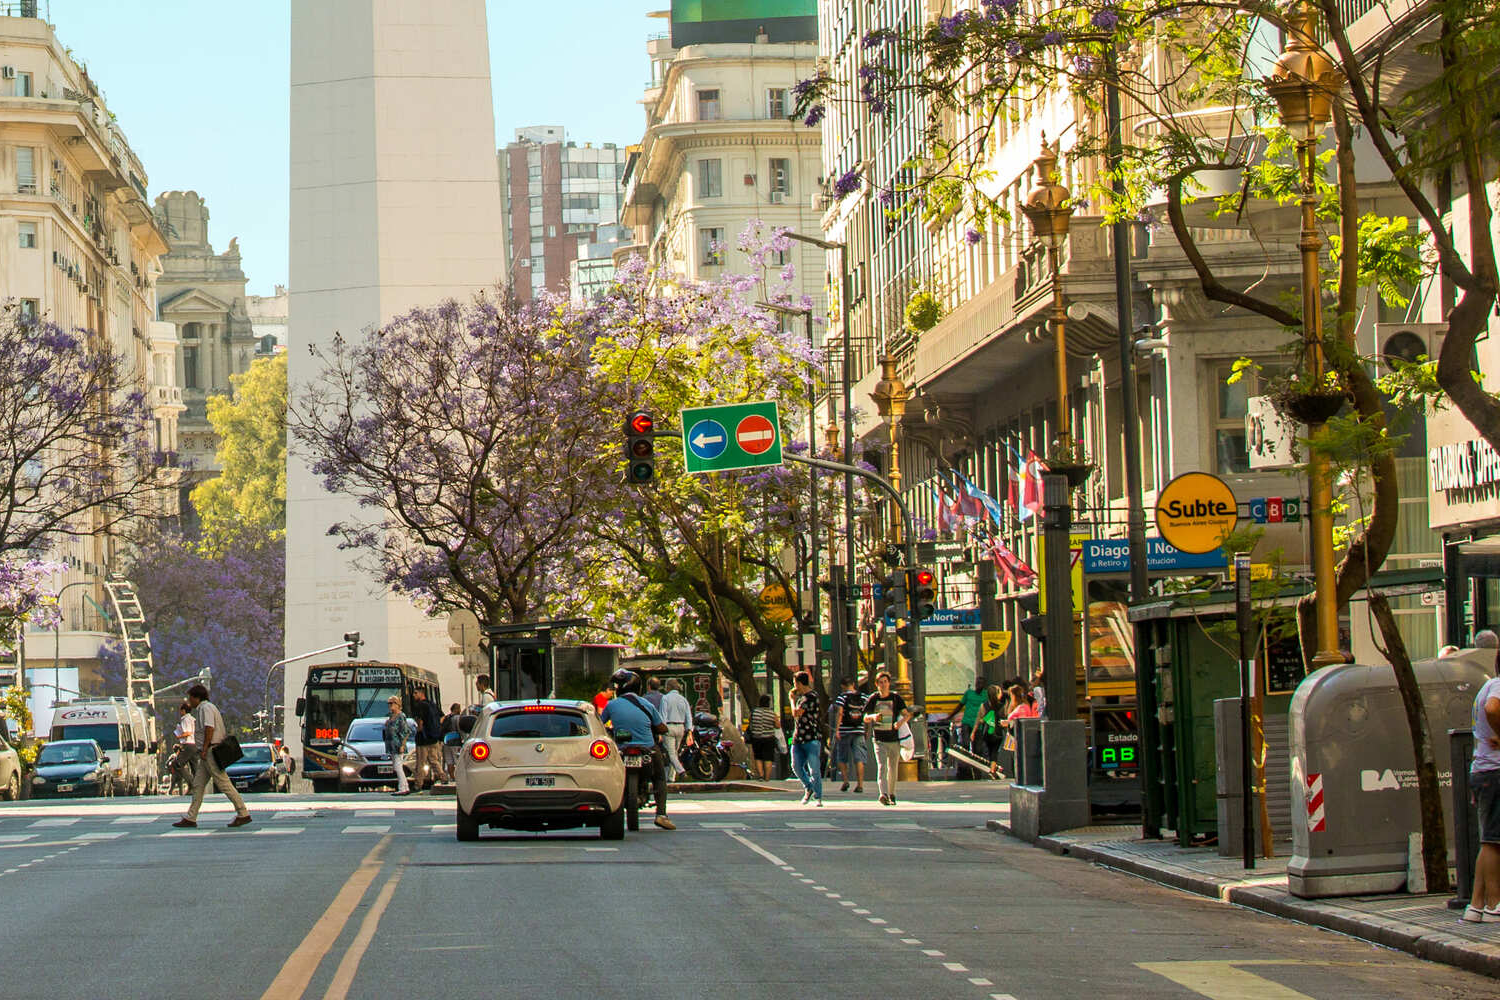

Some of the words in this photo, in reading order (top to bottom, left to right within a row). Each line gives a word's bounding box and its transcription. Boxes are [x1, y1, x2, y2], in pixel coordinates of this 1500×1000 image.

[1167, 499, 1231, 518] Subte
[1252, 504, 1262, 518] C
[1270, 503, 1279, 517] B
[1287, 503, 1297, 515] D
[1090, 543, 1151, 558] Diagol
[1098, 559, 1121, 567] Retiro
[320, 670, 354, 683] 29
[1107, 734, 1138, 743] Estado
[1102, 748, 1116, 762] A
[1120, 747, 1134, 761] B
[1361, 768, 1400, 792] BA
